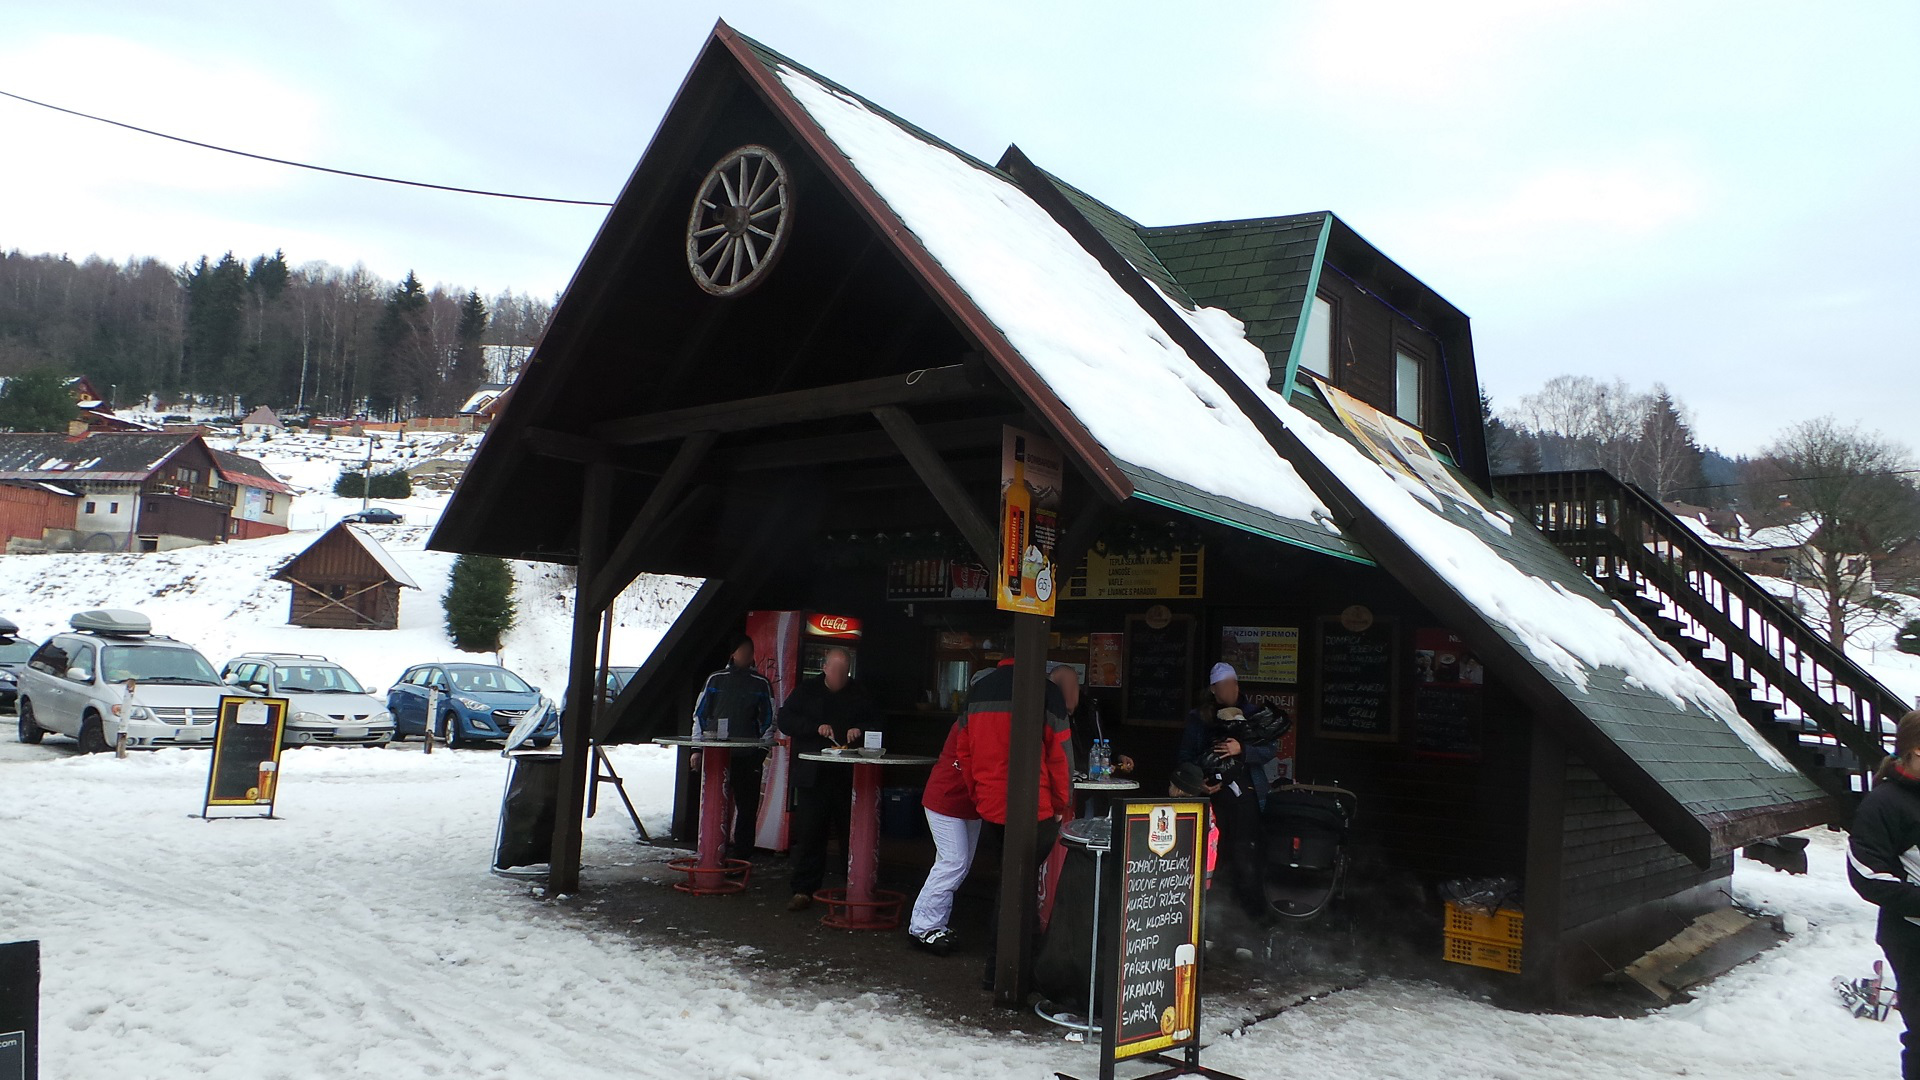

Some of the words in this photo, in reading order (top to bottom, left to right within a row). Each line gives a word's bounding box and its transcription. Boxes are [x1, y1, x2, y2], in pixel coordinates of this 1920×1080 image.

[1108, 578, 1124, 586] VAFLE
[820, 615, 848, 631] Coca-Cola
[1260, 630, 1298, 638] PERMON
[1125, 917, 1142, 933] XXL
[1126, 934, 1160, 957] WRAPP
[1123, 957, 1151, 980] PÁREK
[1151, 959, 1157, 971] V
[1122, 979, 1165, 1005] HRANOLKY
